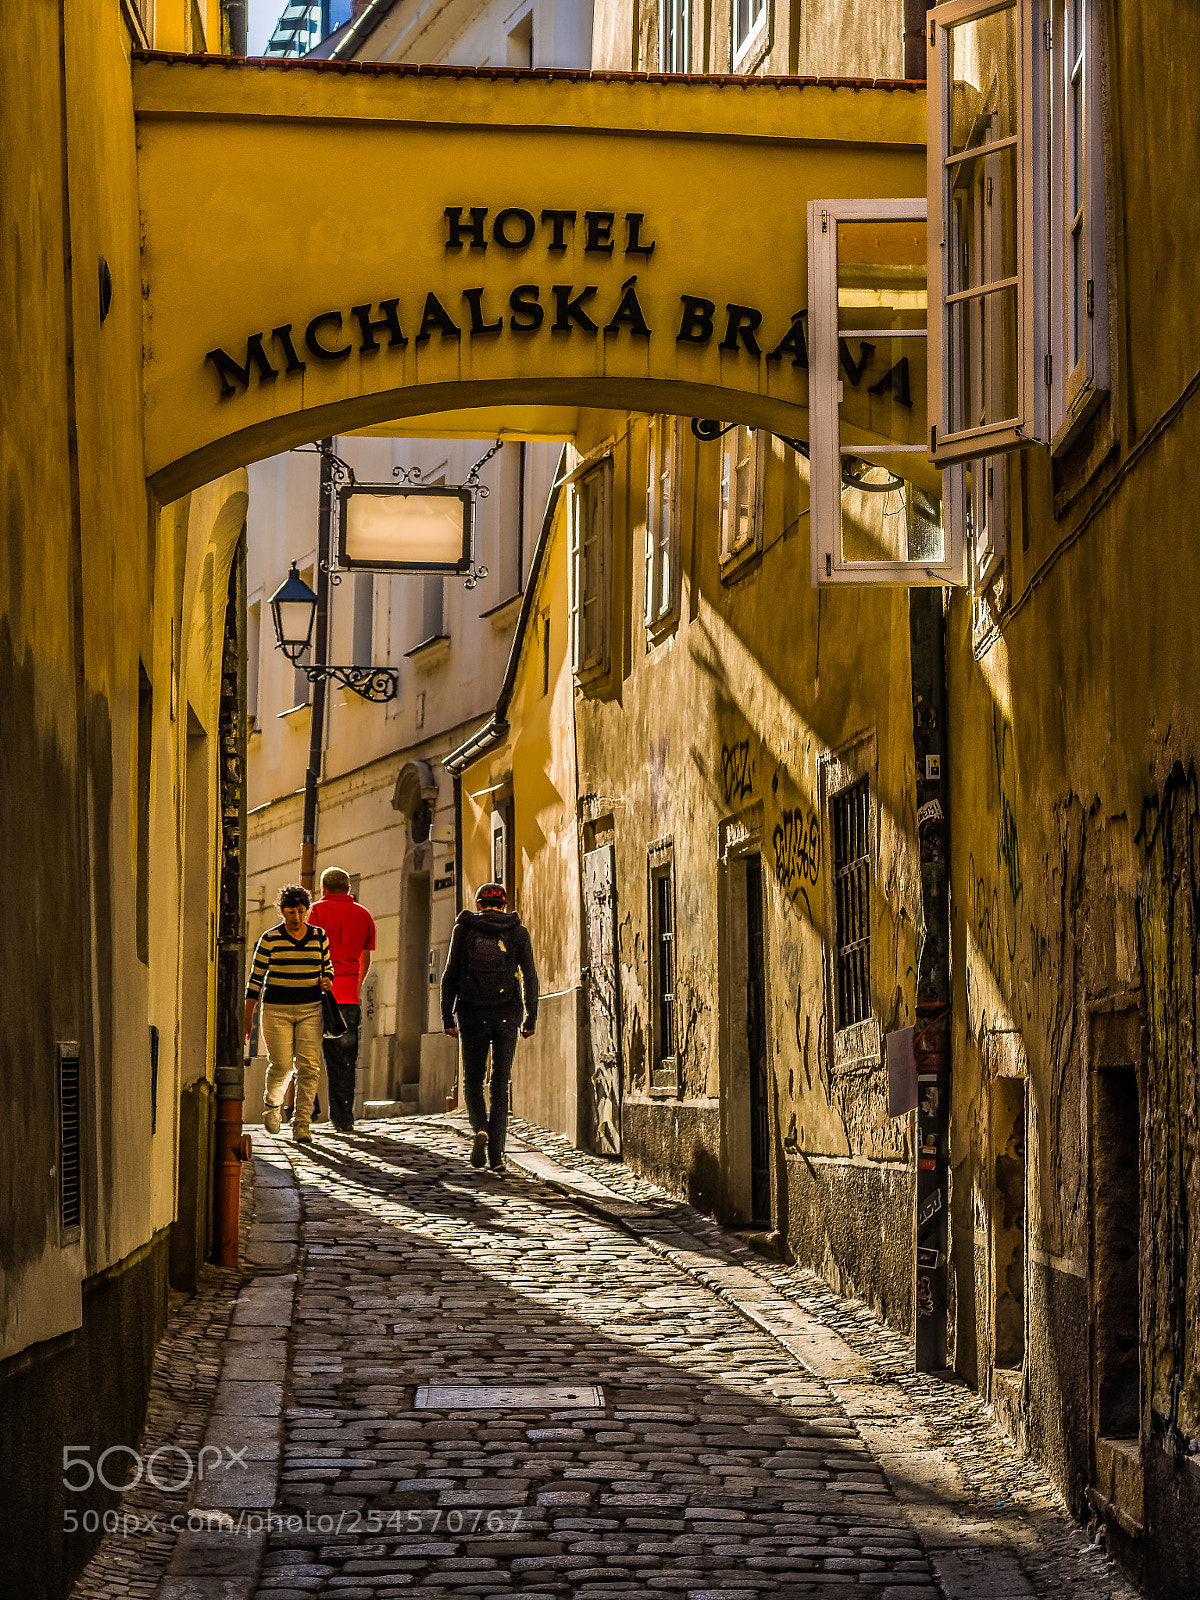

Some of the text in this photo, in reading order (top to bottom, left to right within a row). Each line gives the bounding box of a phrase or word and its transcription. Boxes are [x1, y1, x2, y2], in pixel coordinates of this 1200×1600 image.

[444, 206, 656, 254] HOTEL
[206, 274, 914, 408] MICHALSKÁ BRÁVA
